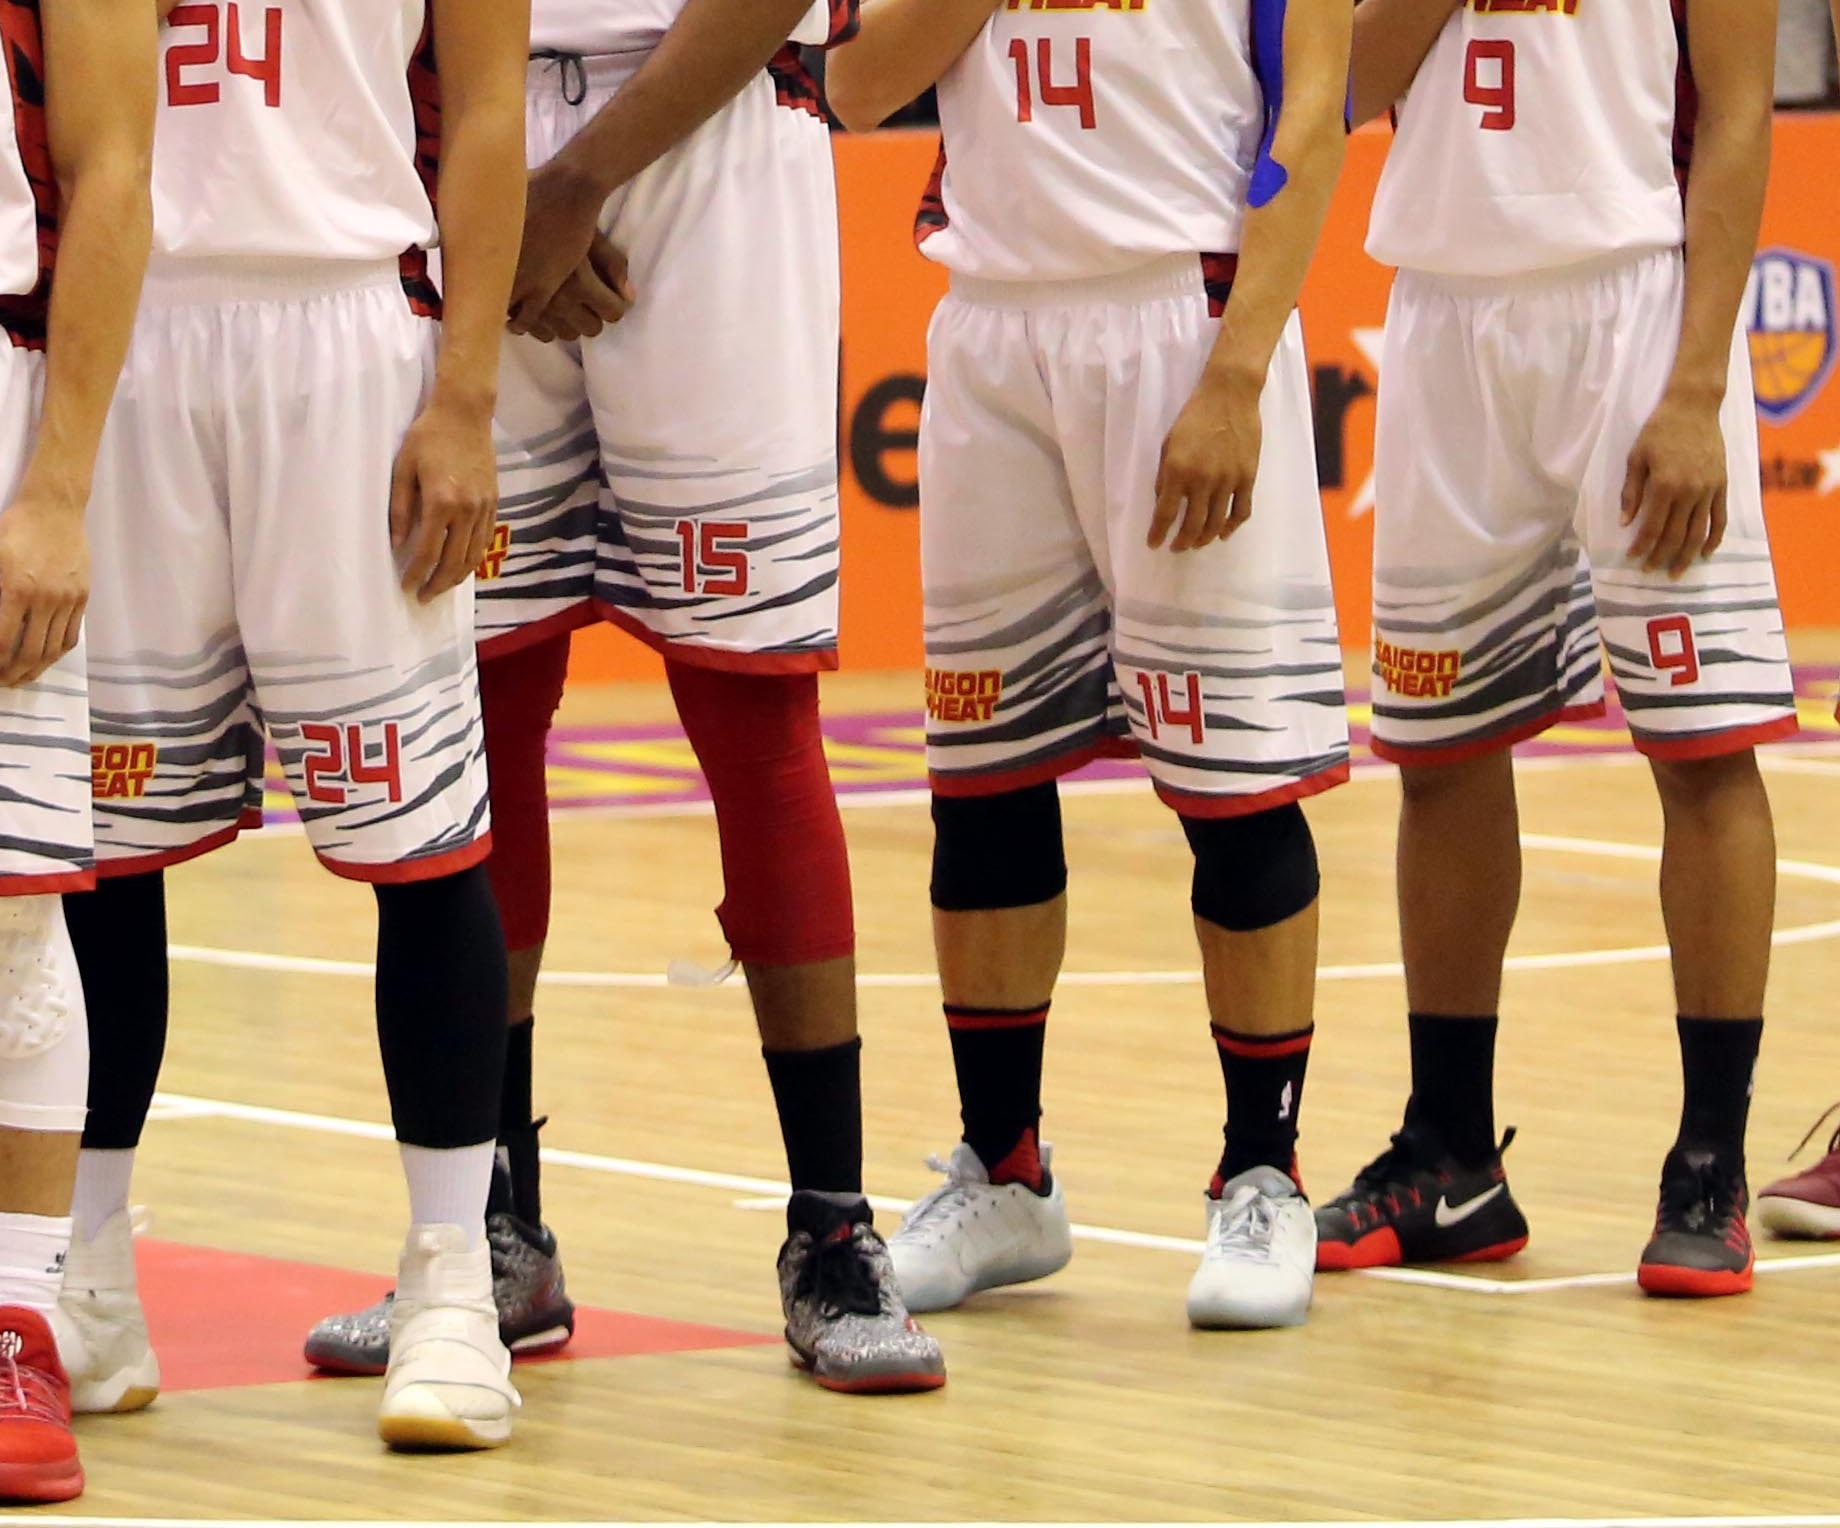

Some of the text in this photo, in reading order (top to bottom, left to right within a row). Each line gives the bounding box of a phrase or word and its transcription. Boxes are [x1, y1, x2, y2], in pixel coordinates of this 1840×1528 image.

[164, 3, 282, 107] 24
[1009, 37, 1096, 130] 14
[1463, 39, 1515, 130] 9
[674, 519, 748, 596] 15
[1386, 669, 1458, 698] HEAT
[1647, 615, 1699, 687] 9
[1136, 672, 1204, 744] 14
[300, 722, 403, 805] 24
